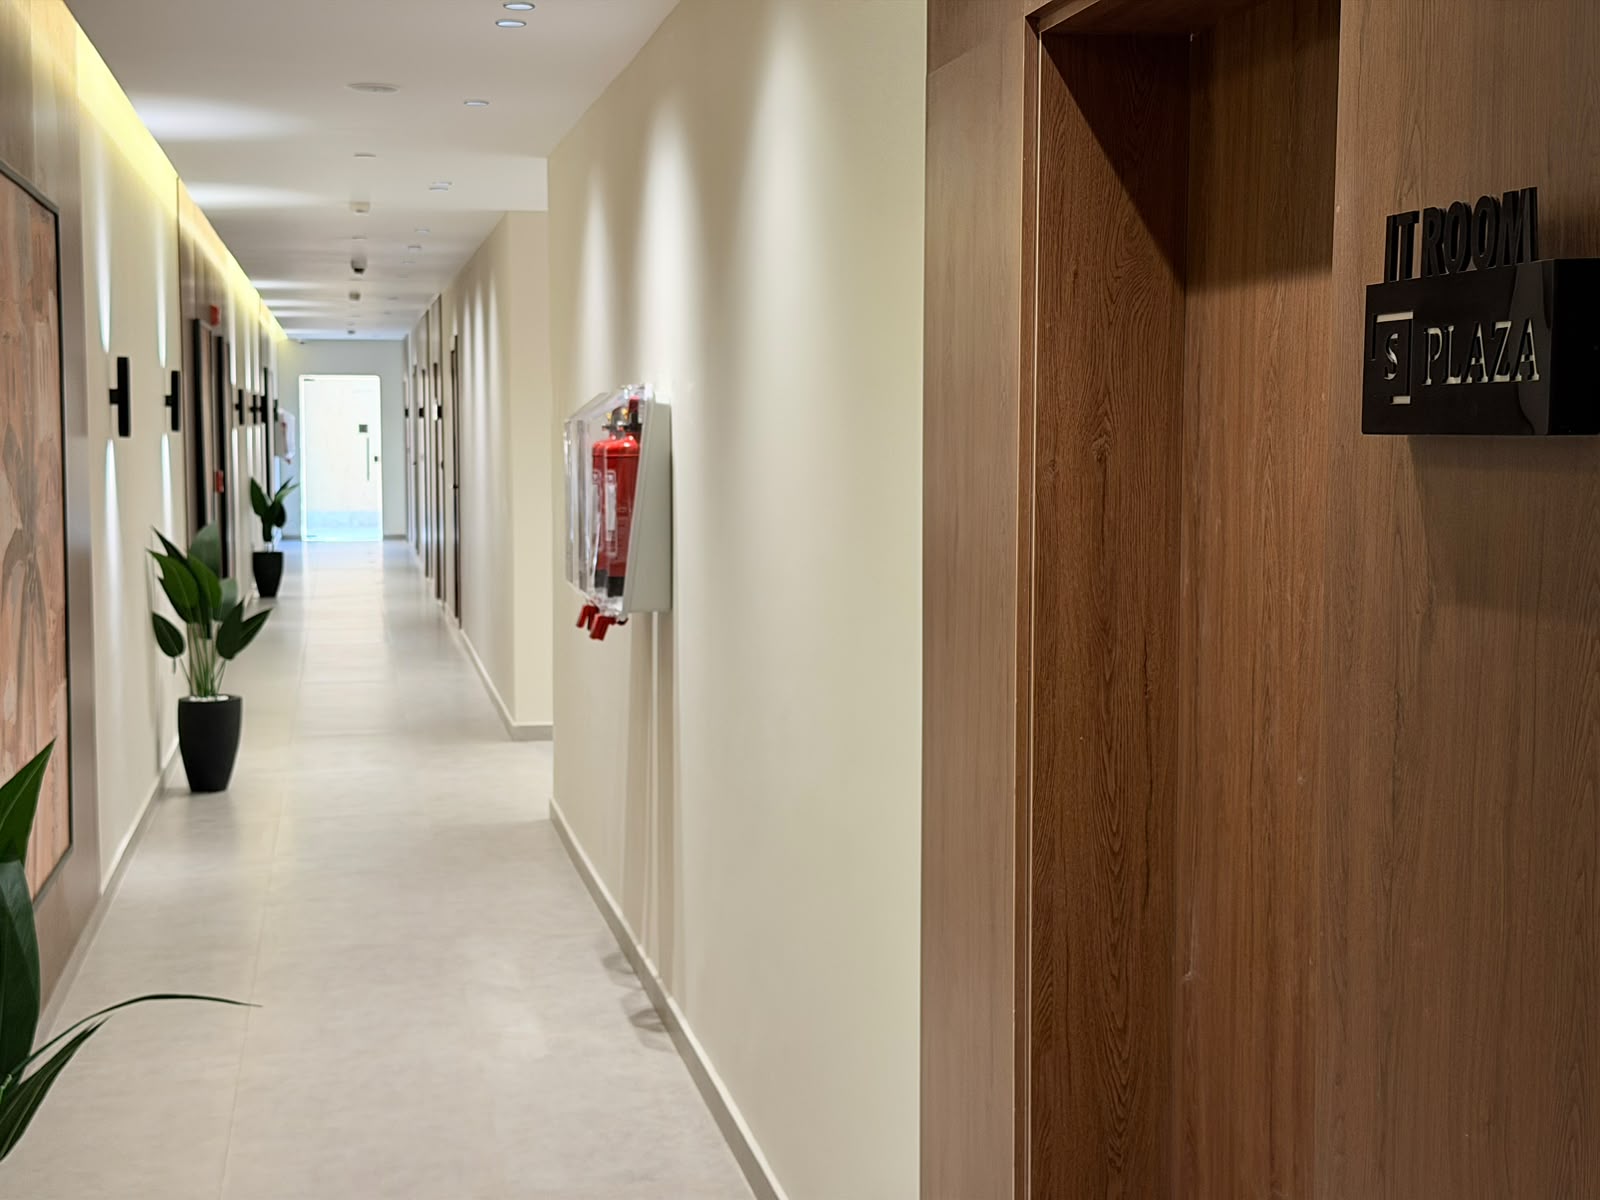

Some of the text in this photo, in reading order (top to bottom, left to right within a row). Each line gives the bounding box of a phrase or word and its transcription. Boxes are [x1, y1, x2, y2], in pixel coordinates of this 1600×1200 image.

[1384, 187, 1539, 283] IT ROOM
[1383, 319, 1540, 386] S PLAZA
